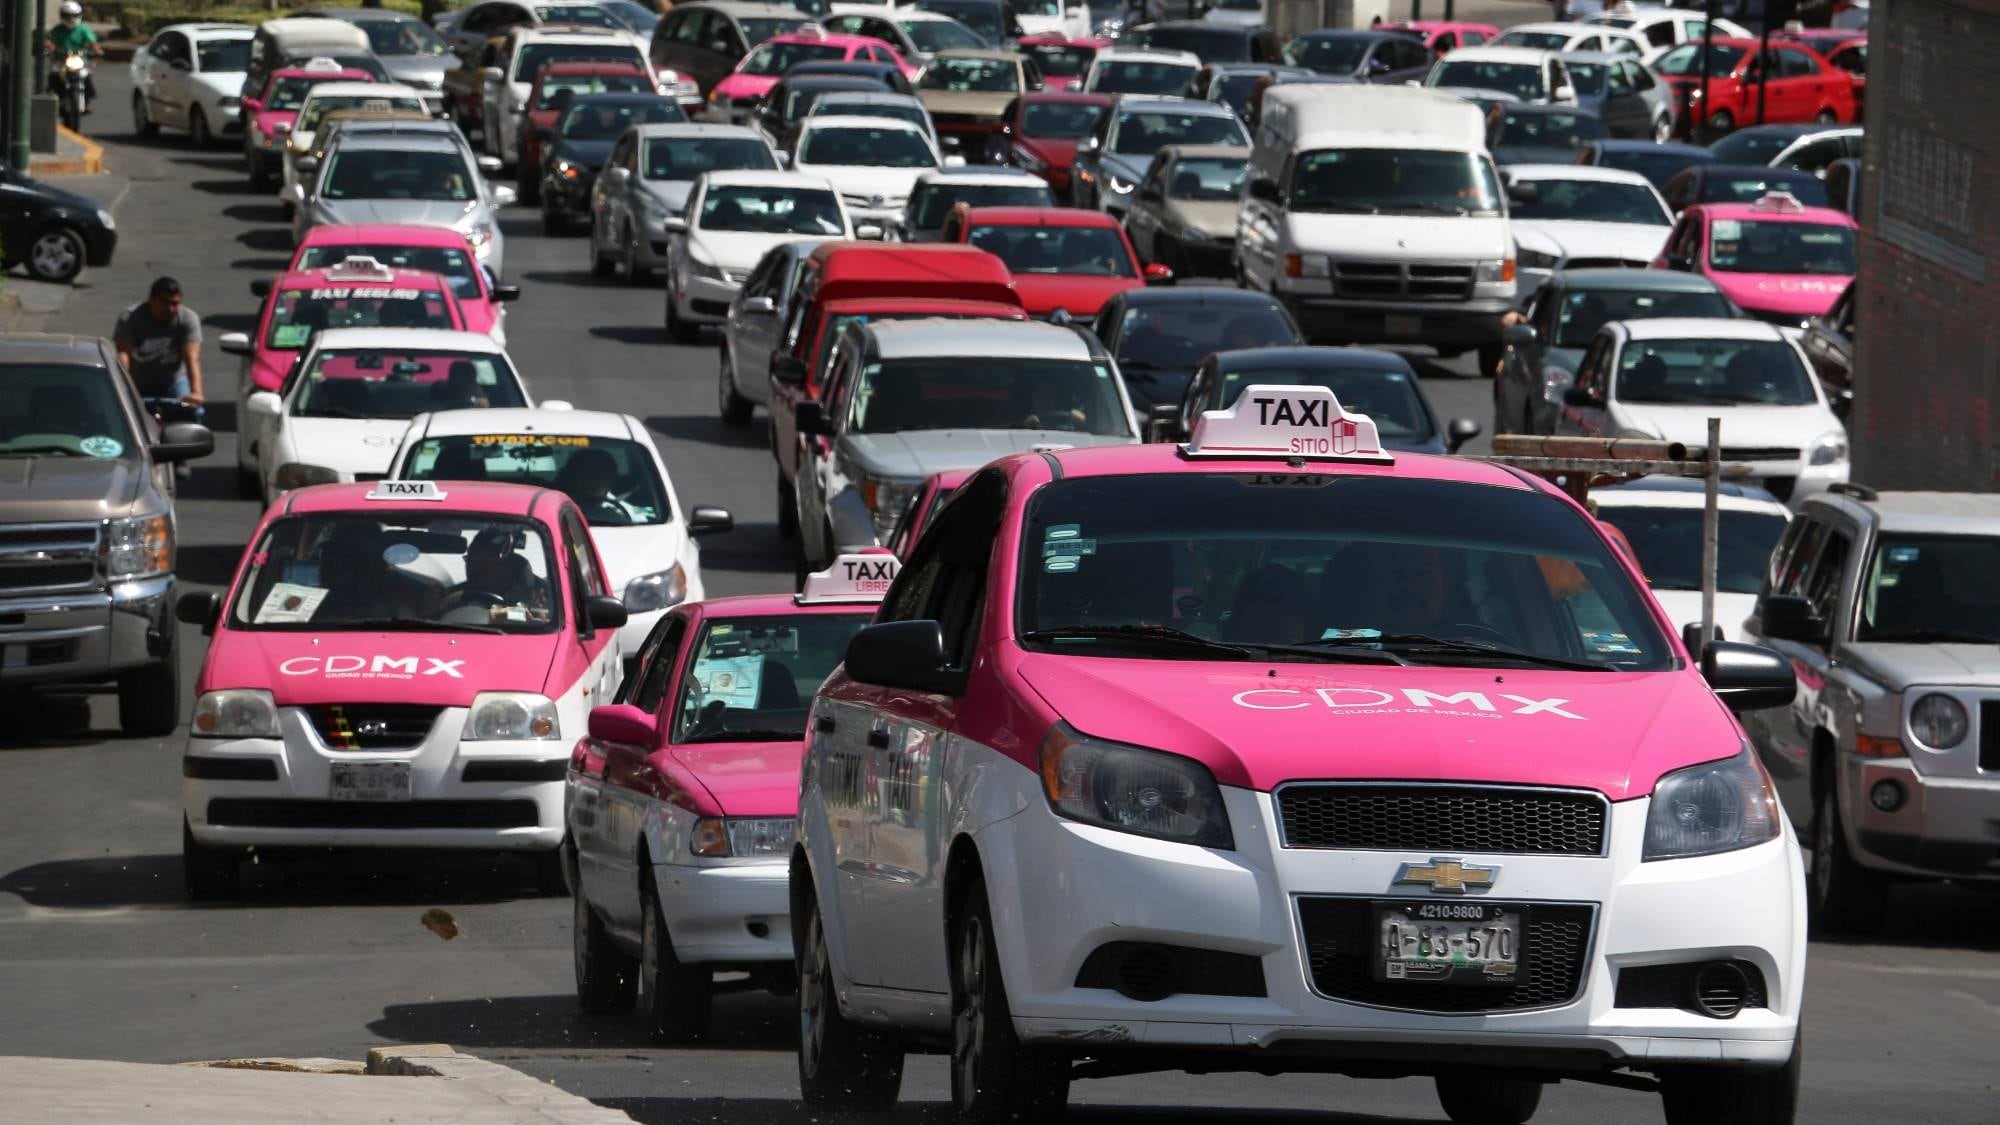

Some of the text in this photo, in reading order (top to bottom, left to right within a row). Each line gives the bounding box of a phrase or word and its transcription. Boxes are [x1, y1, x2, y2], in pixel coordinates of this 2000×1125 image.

[311, 288, 419, 300] TAXI SEGURO
[1253, 398, 1329, 427] TAXI
[1290, 438, 1329, 454] SITIO
[384, 483, 425, 494] TAXI
[842, 561, 894, 580] TAXI
[856, 581, 888, 592] LIBRE
[279, 655, 466, 679] CDMX
[1232, 689, 1587, 720] CDMX
[1420, 905, 1483, 918] 4210-9800
[1389, 923, 1512, 960] A-83-570
